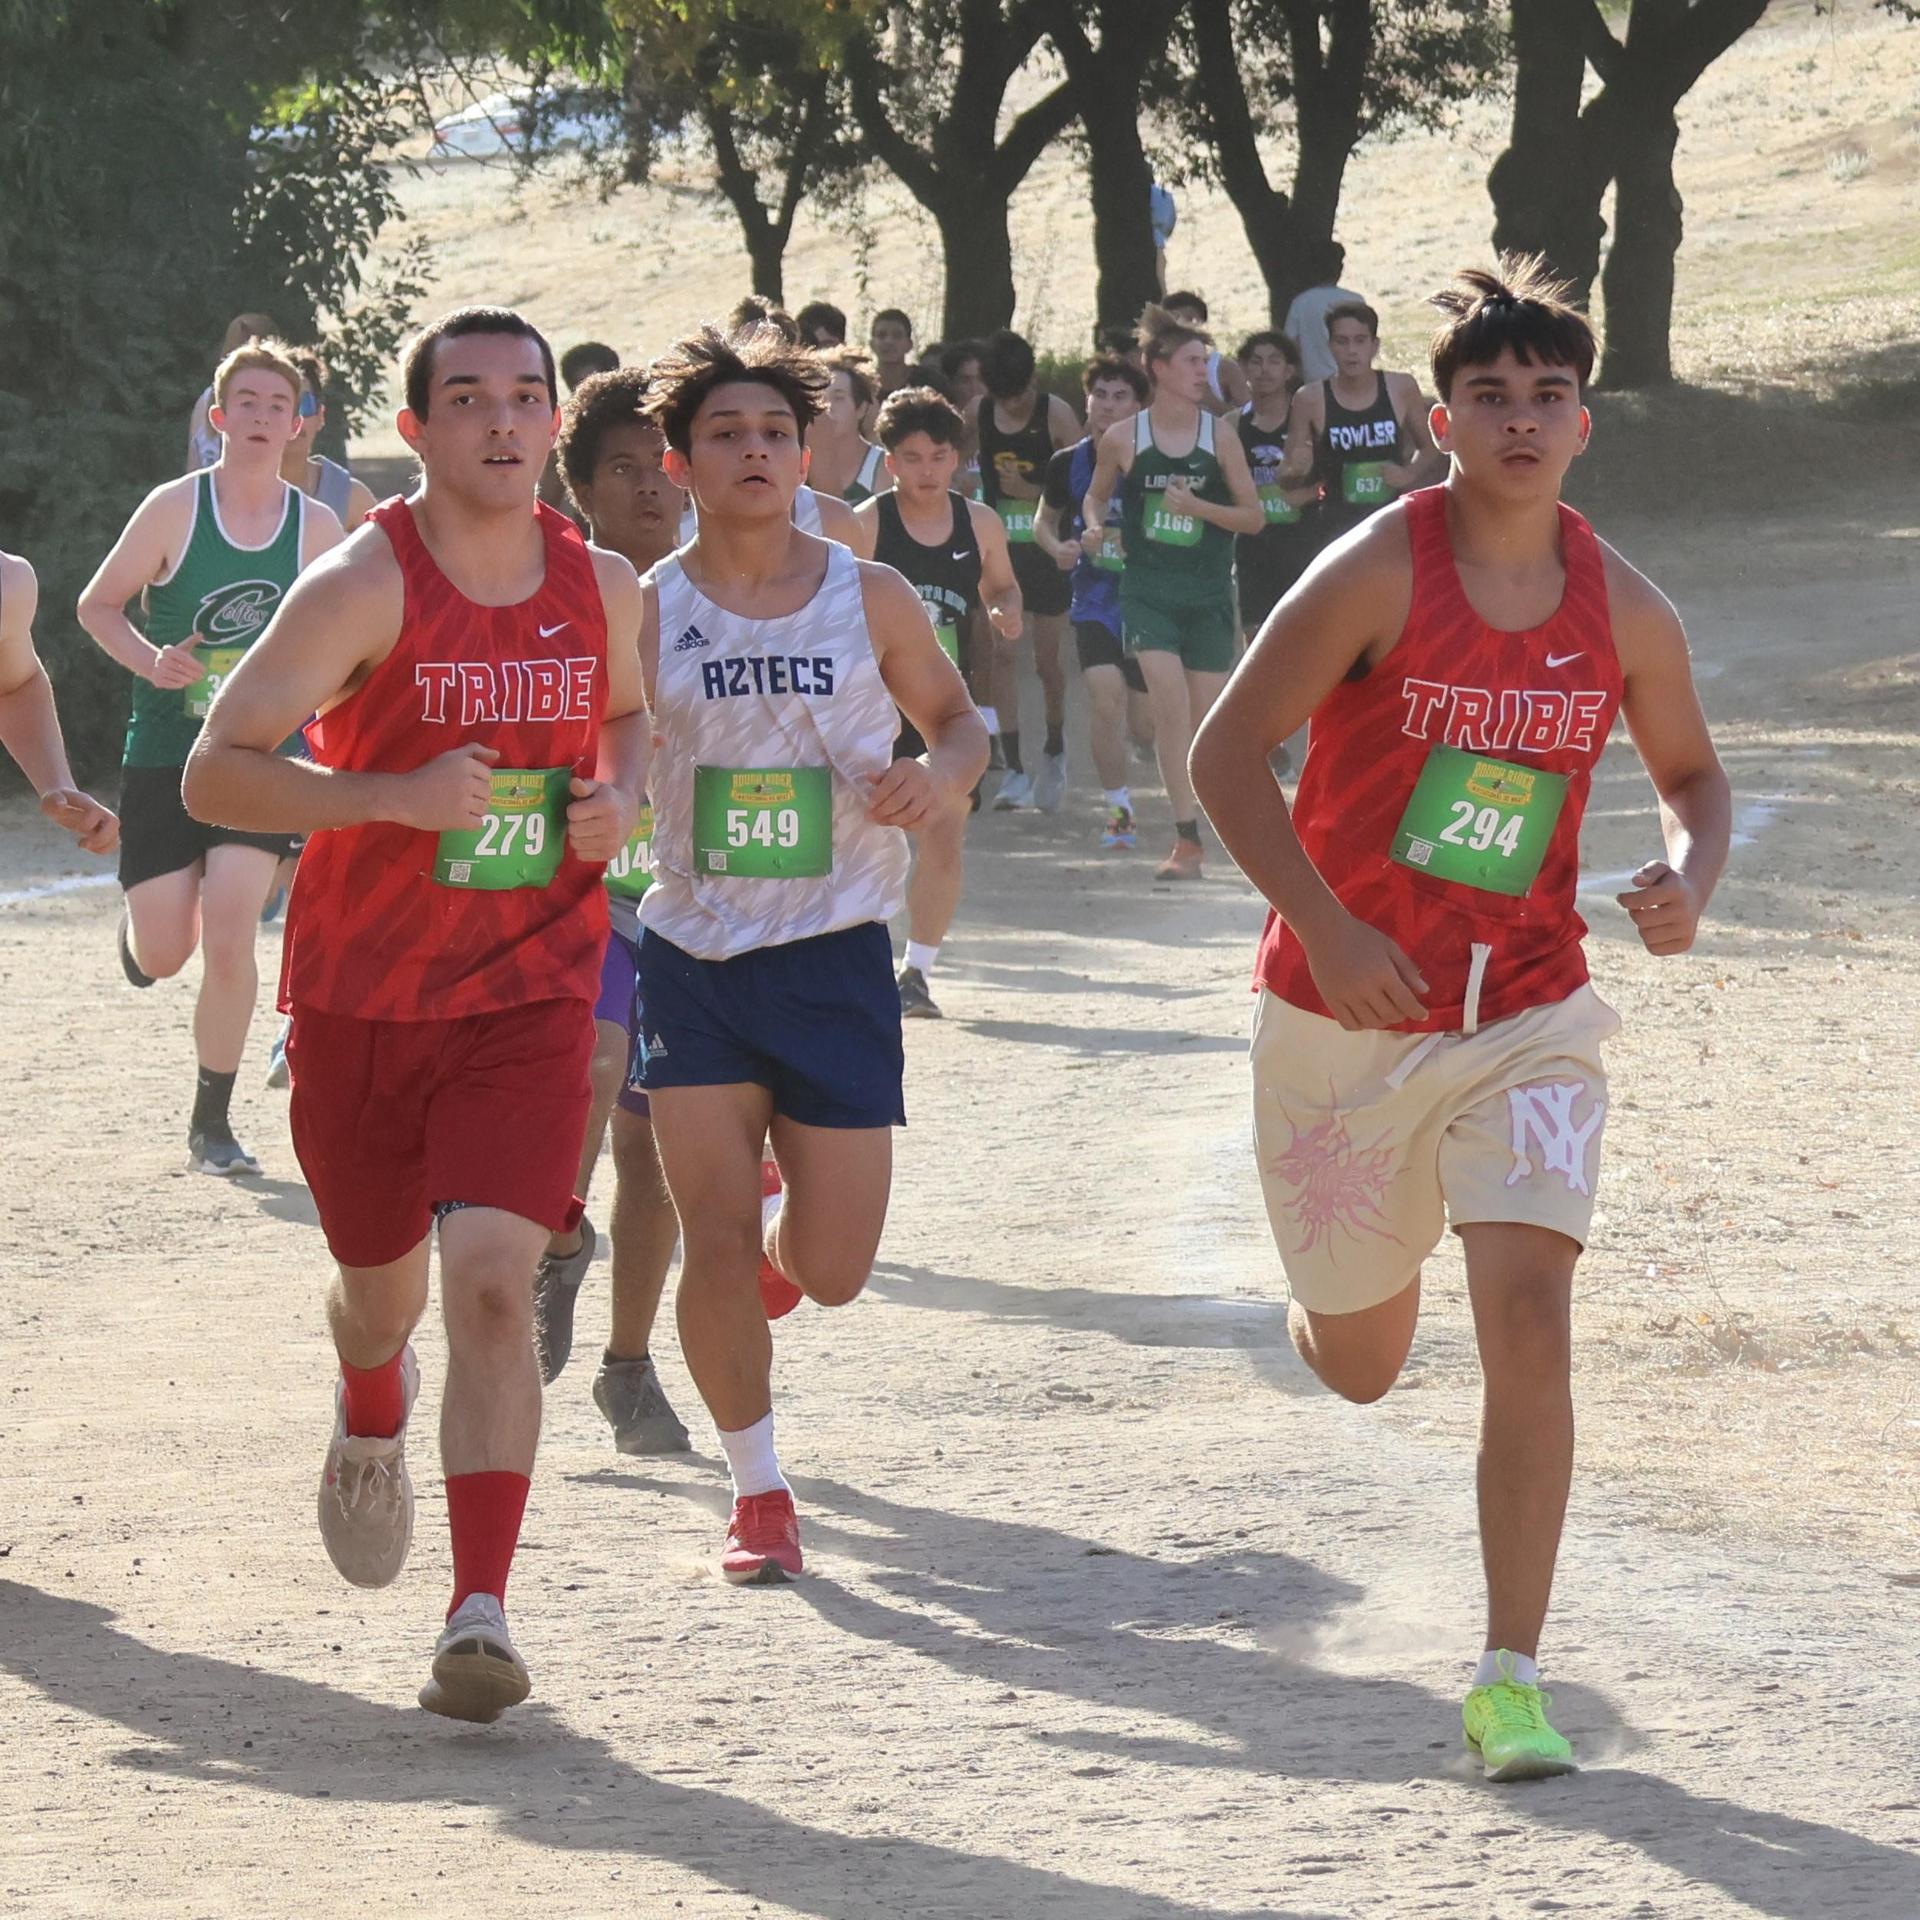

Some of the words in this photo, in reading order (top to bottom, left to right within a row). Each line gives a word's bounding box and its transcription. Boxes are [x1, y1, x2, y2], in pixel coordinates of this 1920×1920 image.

[1329, 420, 1396, 450] FOWLER
[1355, 476, 1383, 492] 637
[1152, 511, 1192, 533] 1166
[674, 638, 711, 652] adidas
[415, 656, 597, 726] TRIBE
[701, 655, 834, 700] AZTECS
[1401, 677, 1607, 753] TRIBE
[474, 812, 545, 856] 279
[726, 808, 799, 847] 549
[1439, 800, 1524, 858] 294
[1505, 1082, 1605, 1196] NY
